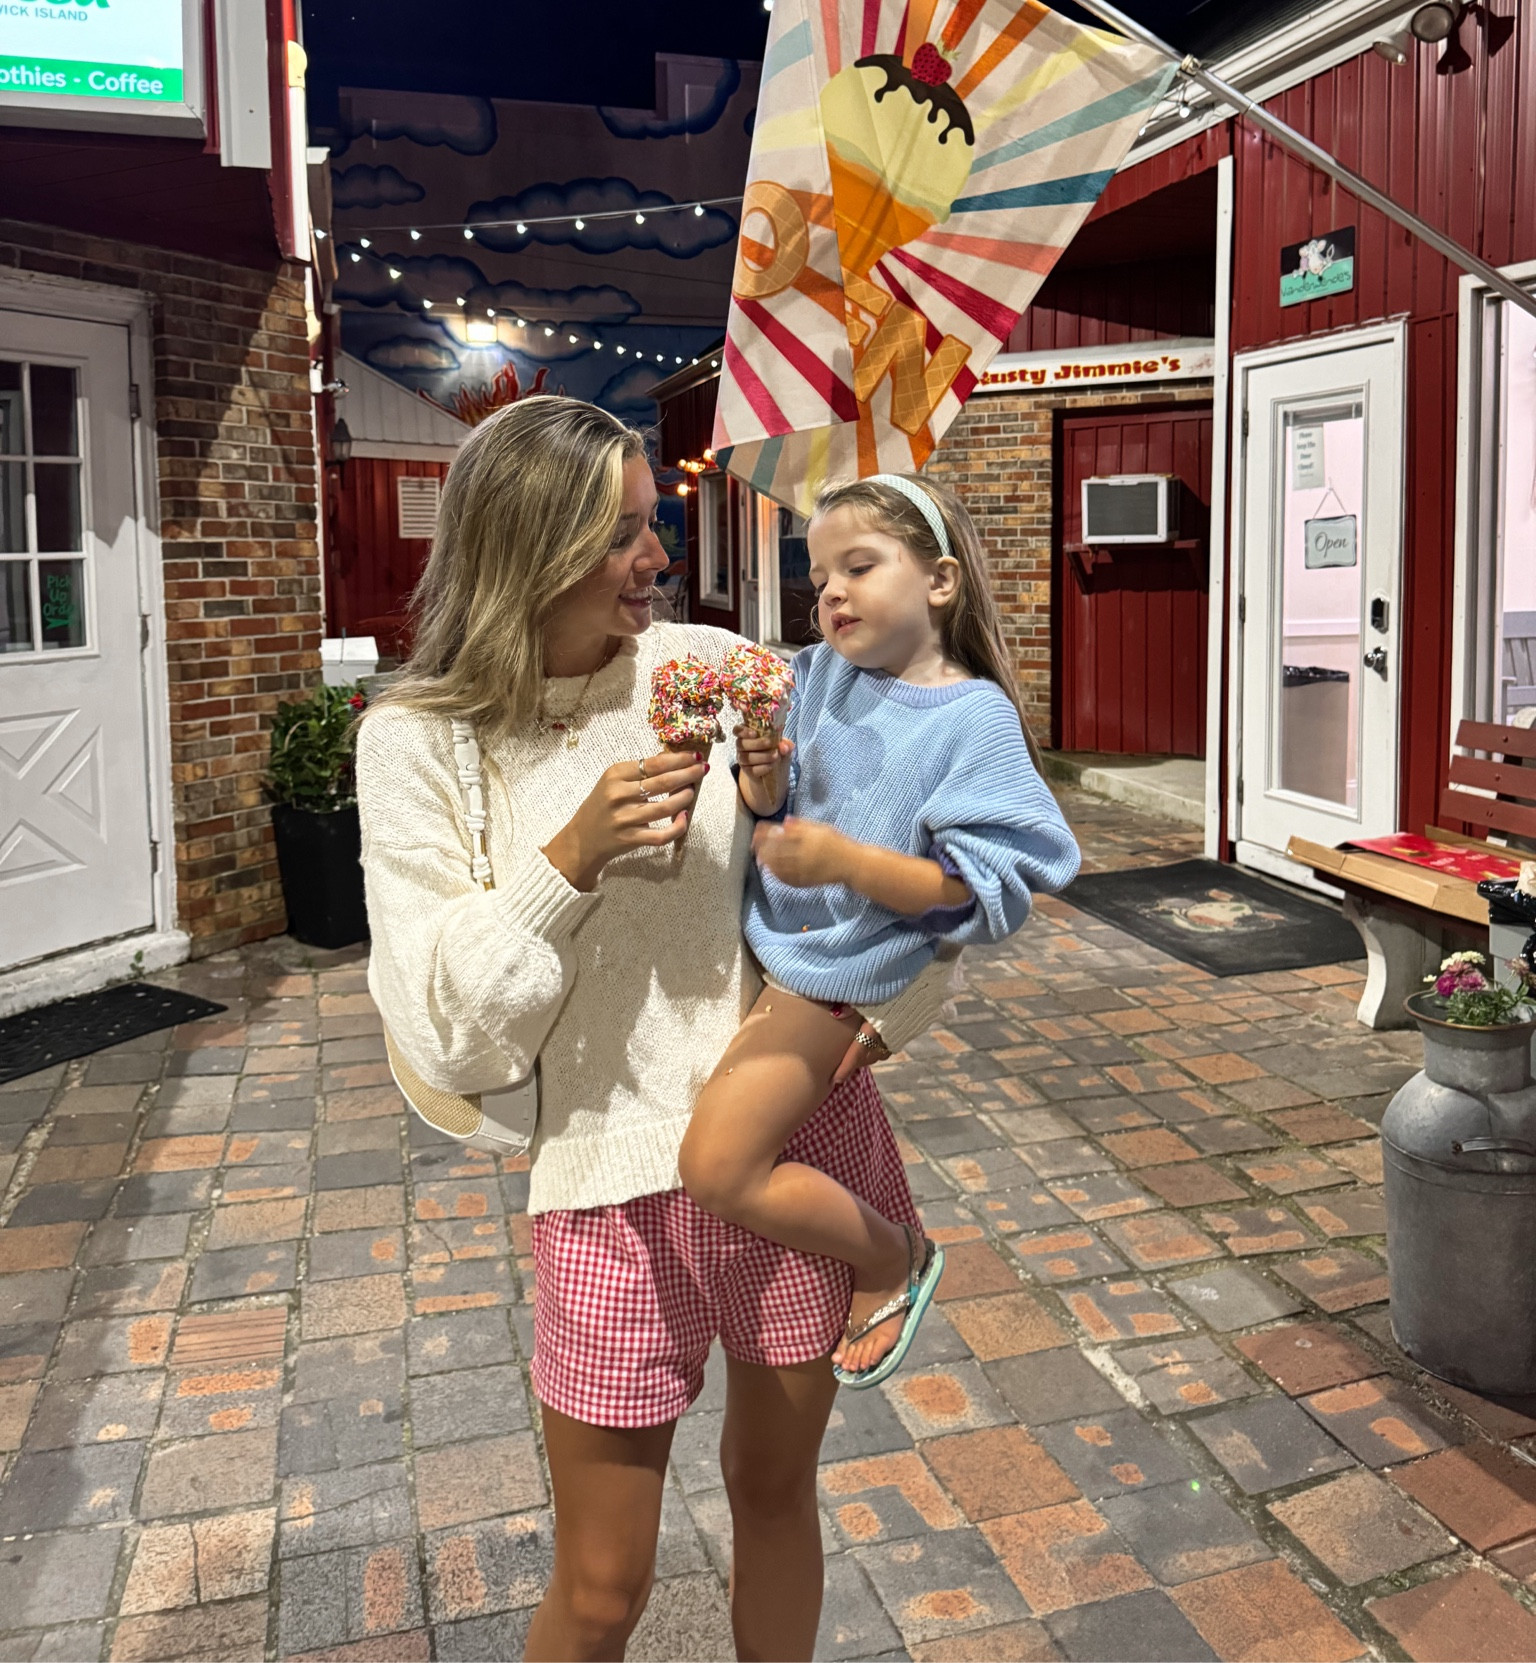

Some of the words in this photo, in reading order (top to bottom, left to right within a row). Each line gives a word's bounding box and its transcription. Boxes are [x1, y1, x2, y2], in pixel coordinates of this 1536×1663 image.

[35, 7, 89, 21] ISLAND
[88, 70, 164, 95] Coffee
[1054, 356, 1181, 380] Jimmie's
[1314, 531, 1349, 558] Open
[49, 589, 68, 604] Up
